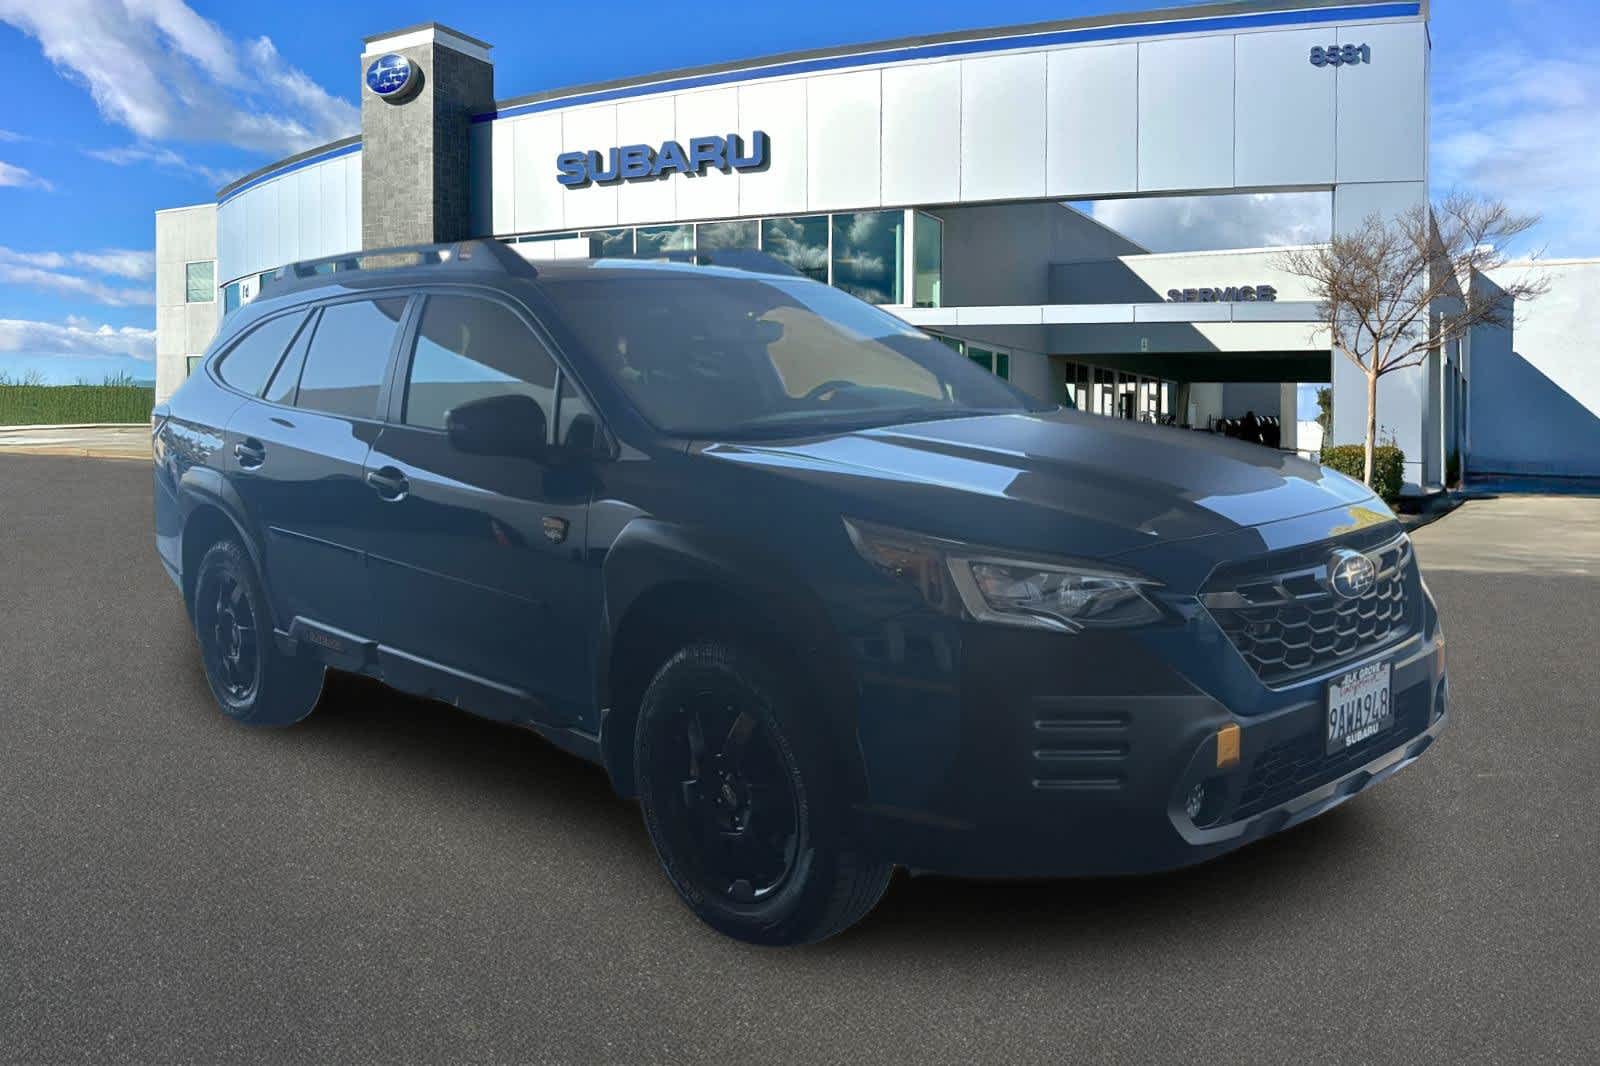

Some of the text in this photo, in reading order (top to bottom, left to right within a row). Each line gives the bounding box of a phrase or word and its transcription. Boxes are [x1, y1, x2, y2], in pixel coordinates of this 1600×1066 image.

[556, 130, 771, 190] SUBARU
[1166, 285, 1277, 302] SERVICE
[1345, 722, 1379, 747] SUBARU
